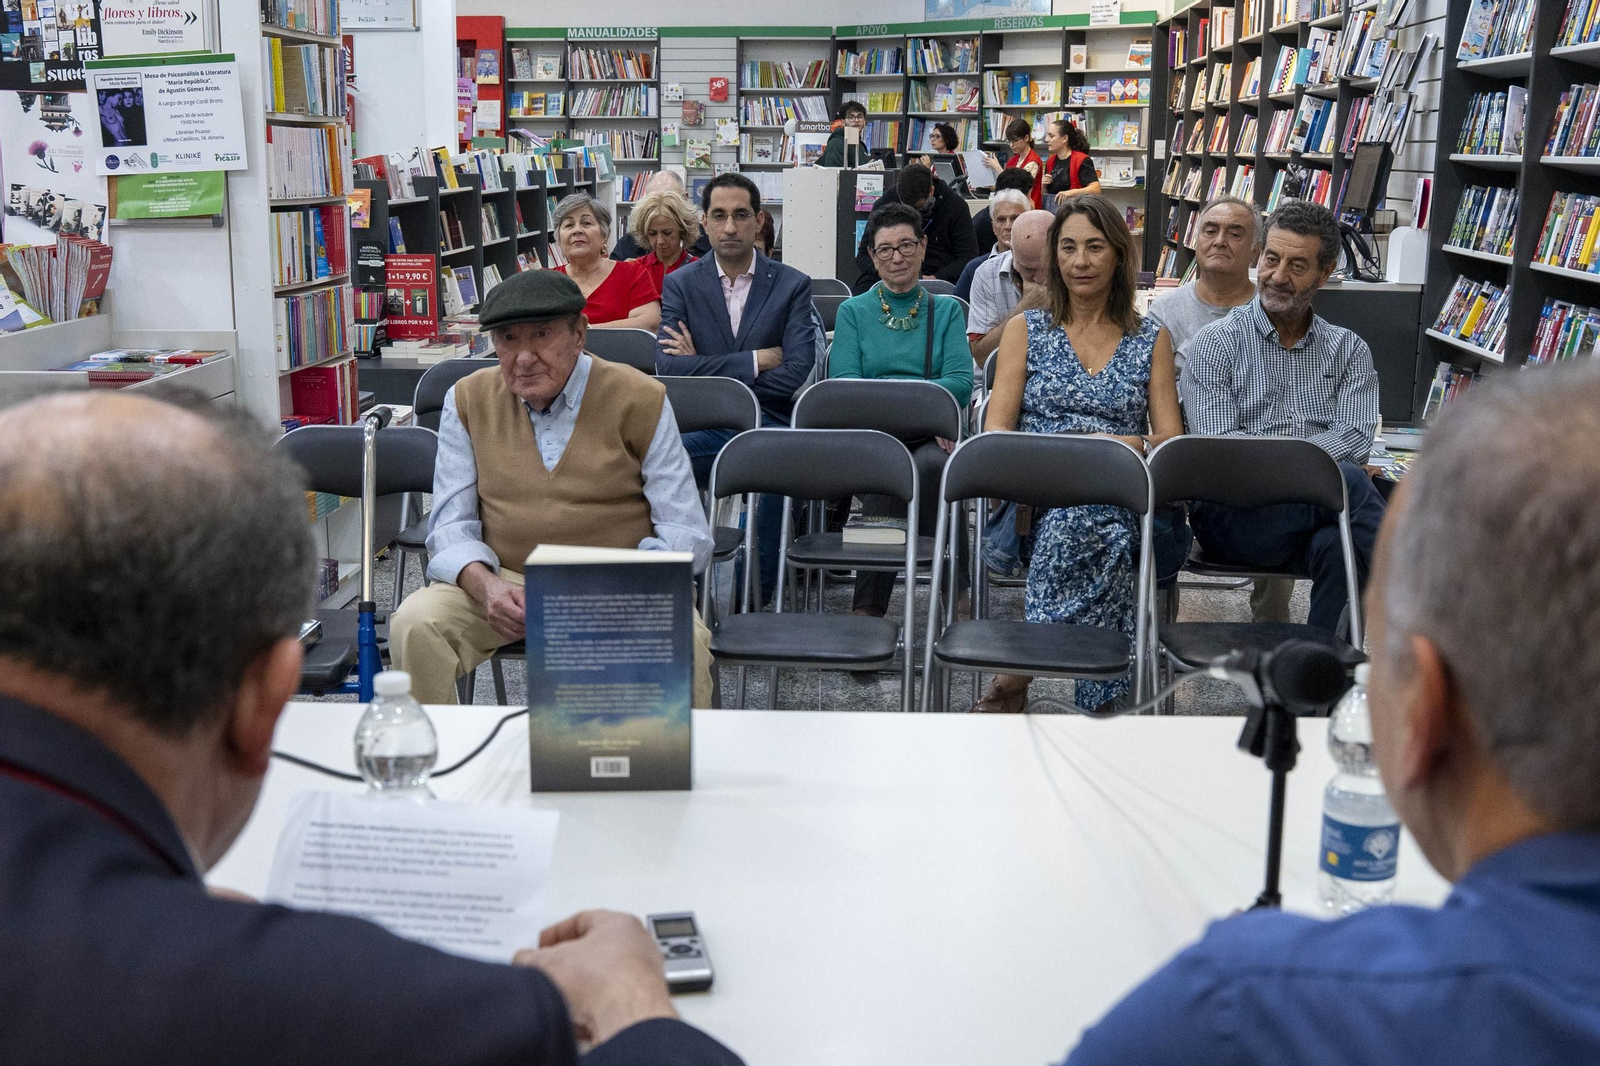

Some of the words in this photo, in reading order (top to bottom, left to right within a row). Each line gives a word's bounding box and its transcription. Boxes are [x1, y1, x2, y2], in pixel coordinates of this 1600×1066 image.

[102, 7, 134, 20] flores
[138, 9, 144, 20] y
[148, 7, 182, 18] libros.
[994, 17, 1044, 29] RESERVAS
[567, 27, 658, 38] MANUALIDADES
[856, 25, 888, 36] APOYO
[78, 50, 98, 60] ros
[712, 79, 725, 89] 365
[215, 153, 240, 162] Picasso
